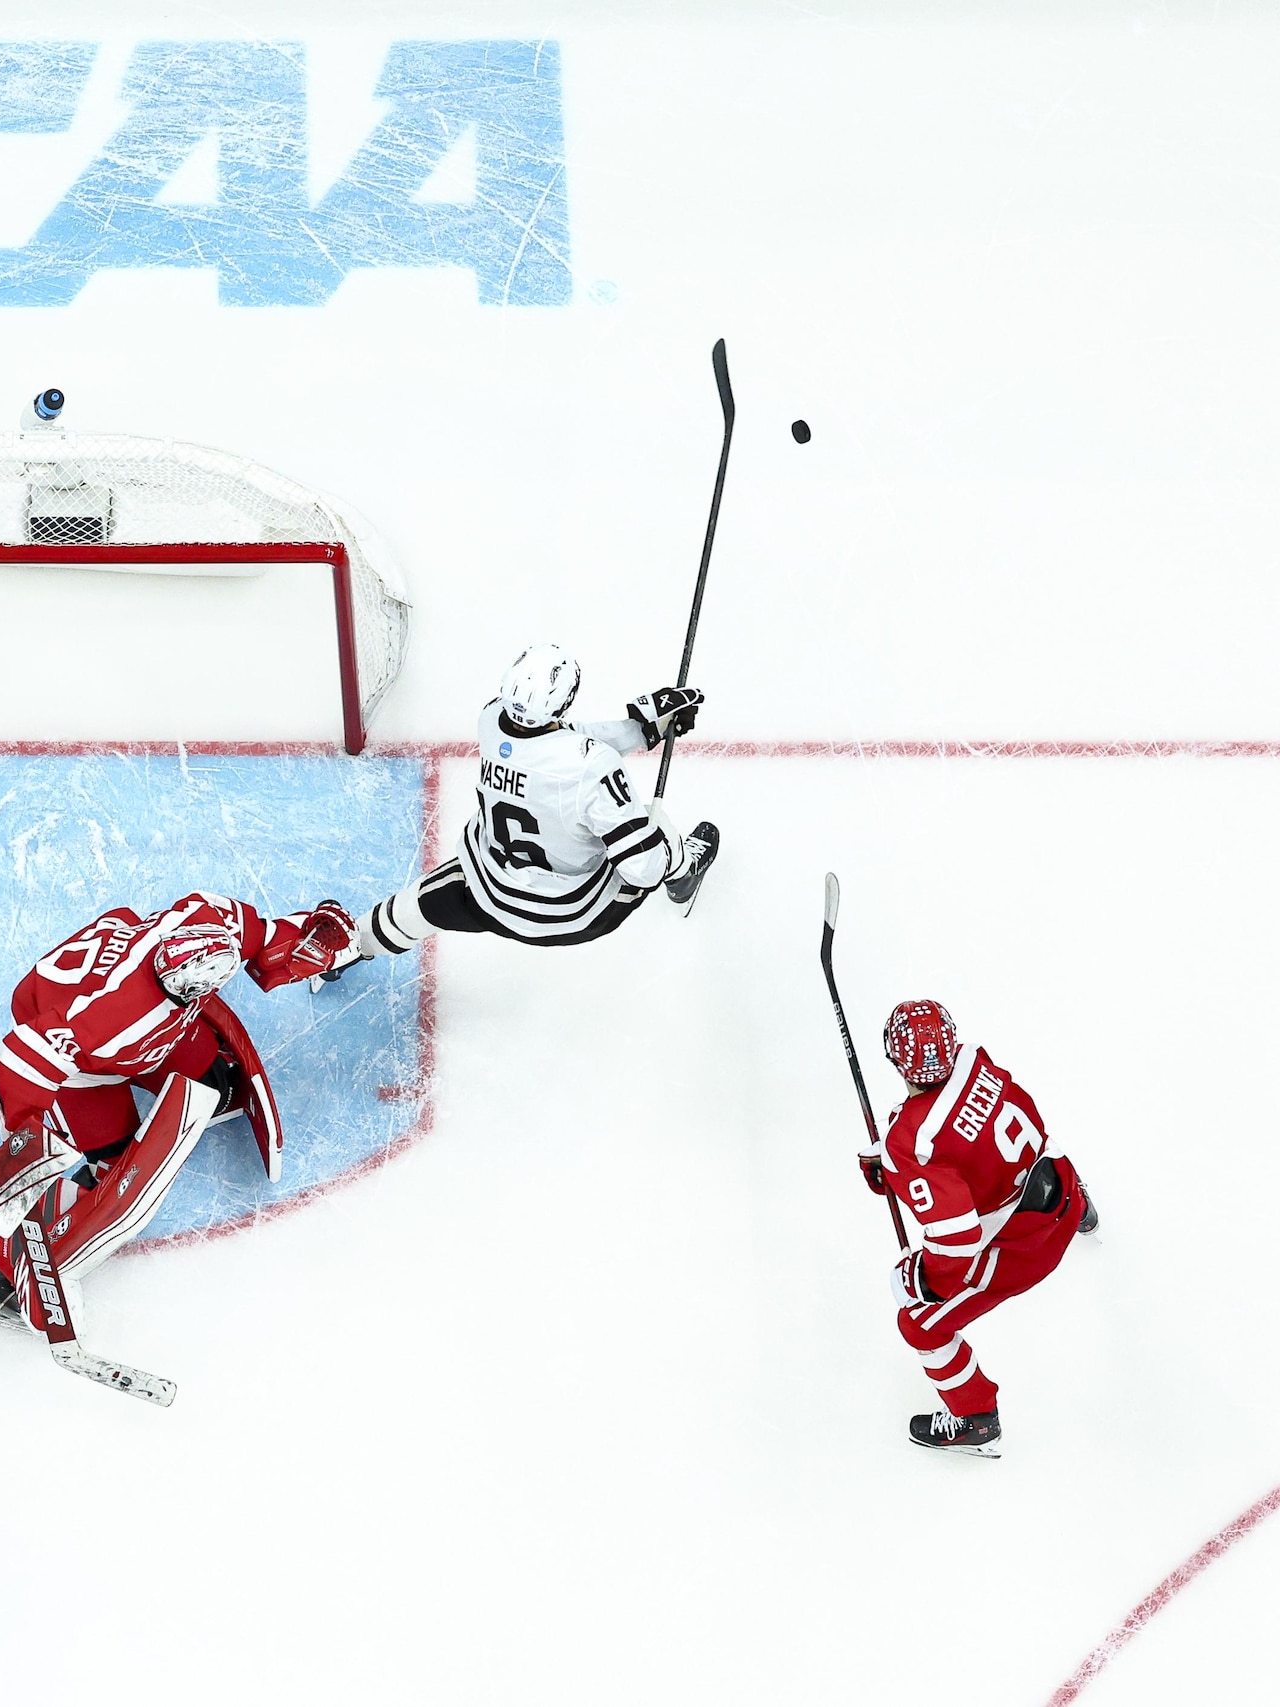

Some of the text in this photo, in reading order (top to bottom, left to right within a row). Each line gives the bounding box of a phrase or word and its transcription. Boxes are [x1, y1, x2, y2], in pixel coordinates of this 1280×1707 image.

[953, 1064, 1004, 1142] GREENE
[994, 1100, 1044, 1187] 9
[908, 1177, 935, 1213] 9
[21, 1219, 67, 1326] BAUER
